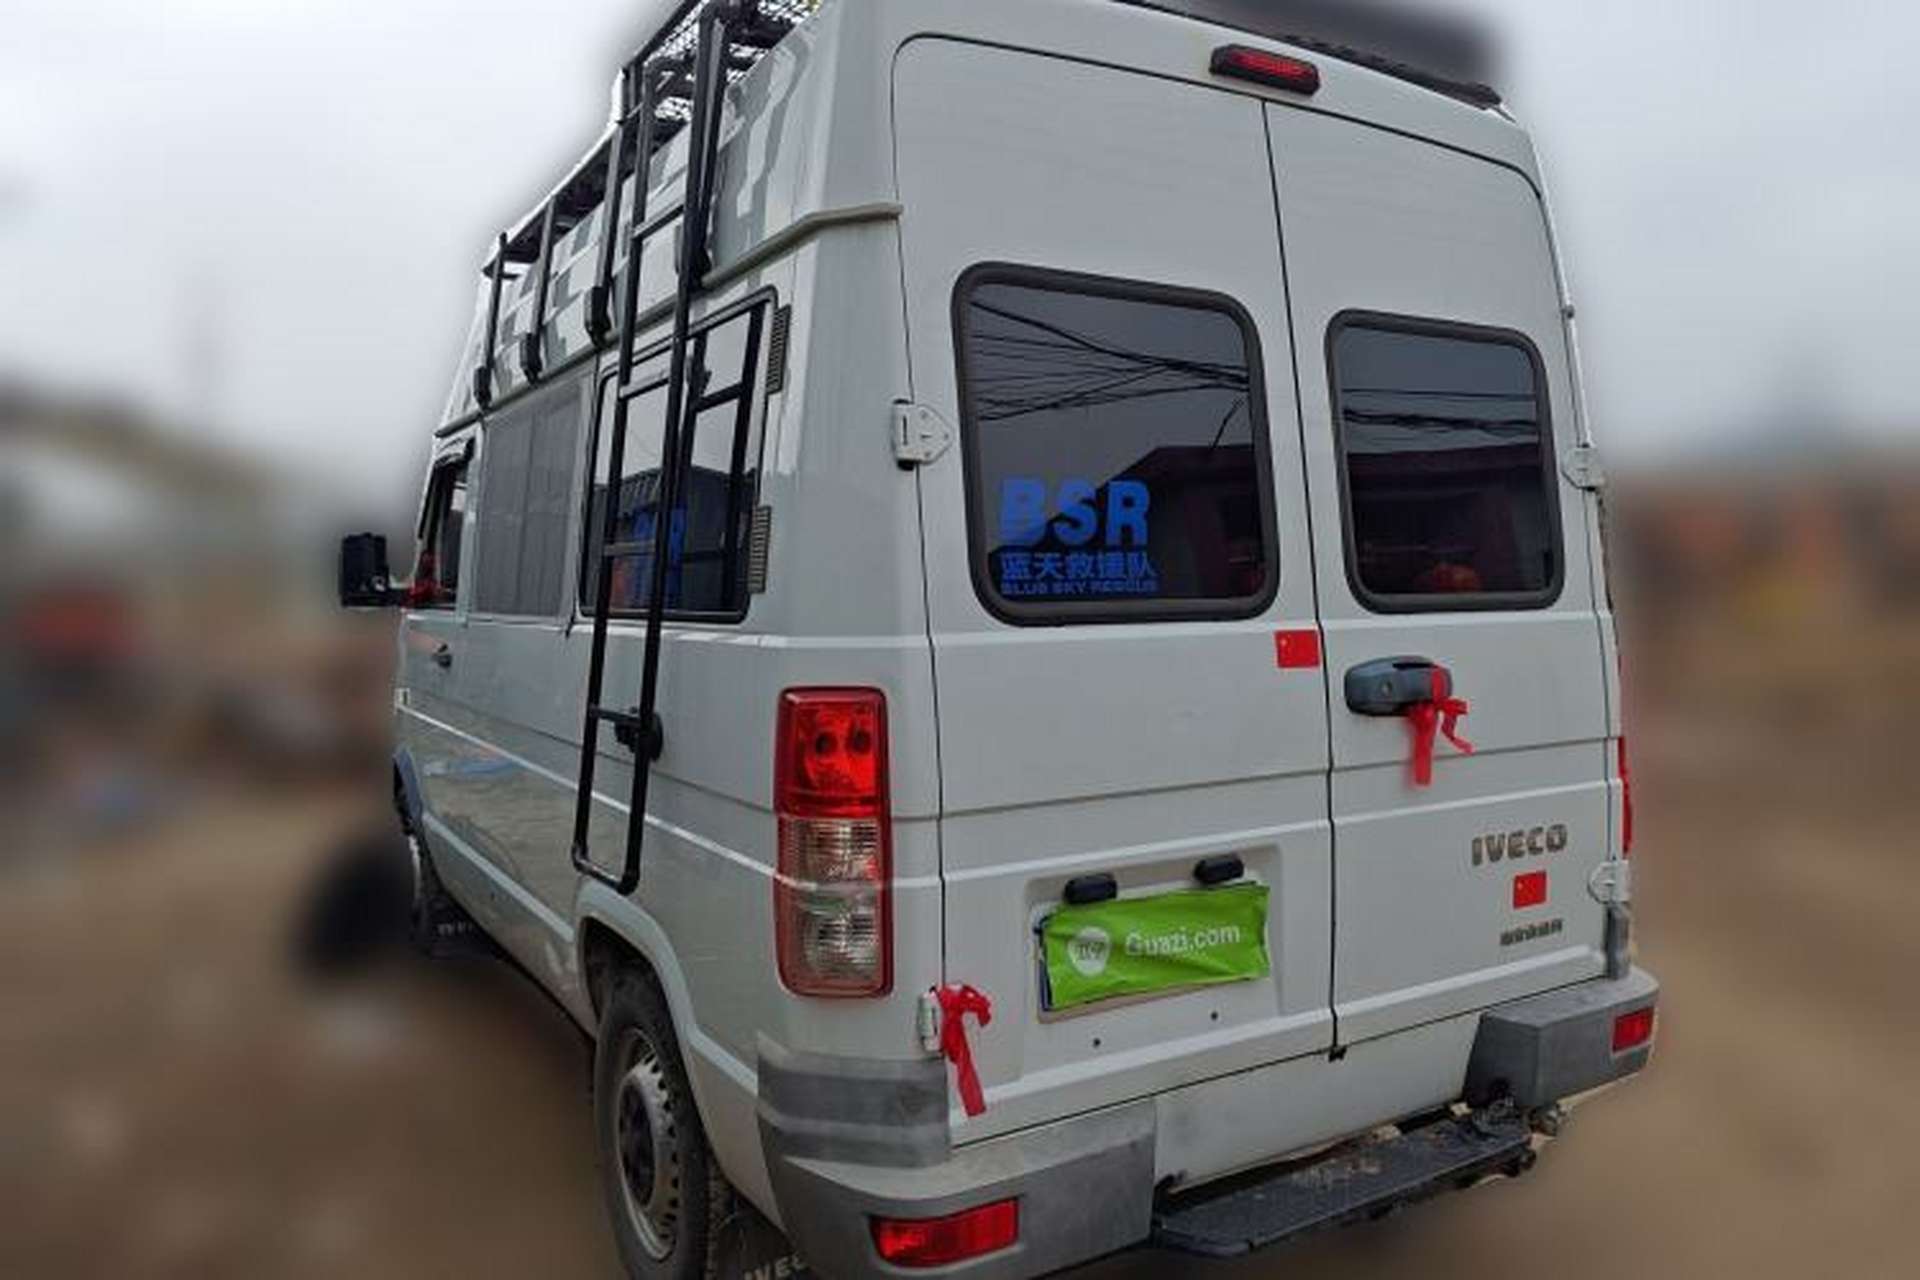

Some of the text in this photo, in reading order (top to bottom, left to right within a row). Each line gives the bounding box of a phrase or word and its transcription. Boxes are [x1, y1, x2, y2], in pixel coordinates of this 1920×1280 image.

[1001, 478, 1149, 547] BSR
[1471, 823, 1568, 867] IVECO
[1125, 924, 1241, 957] Guazi.com
